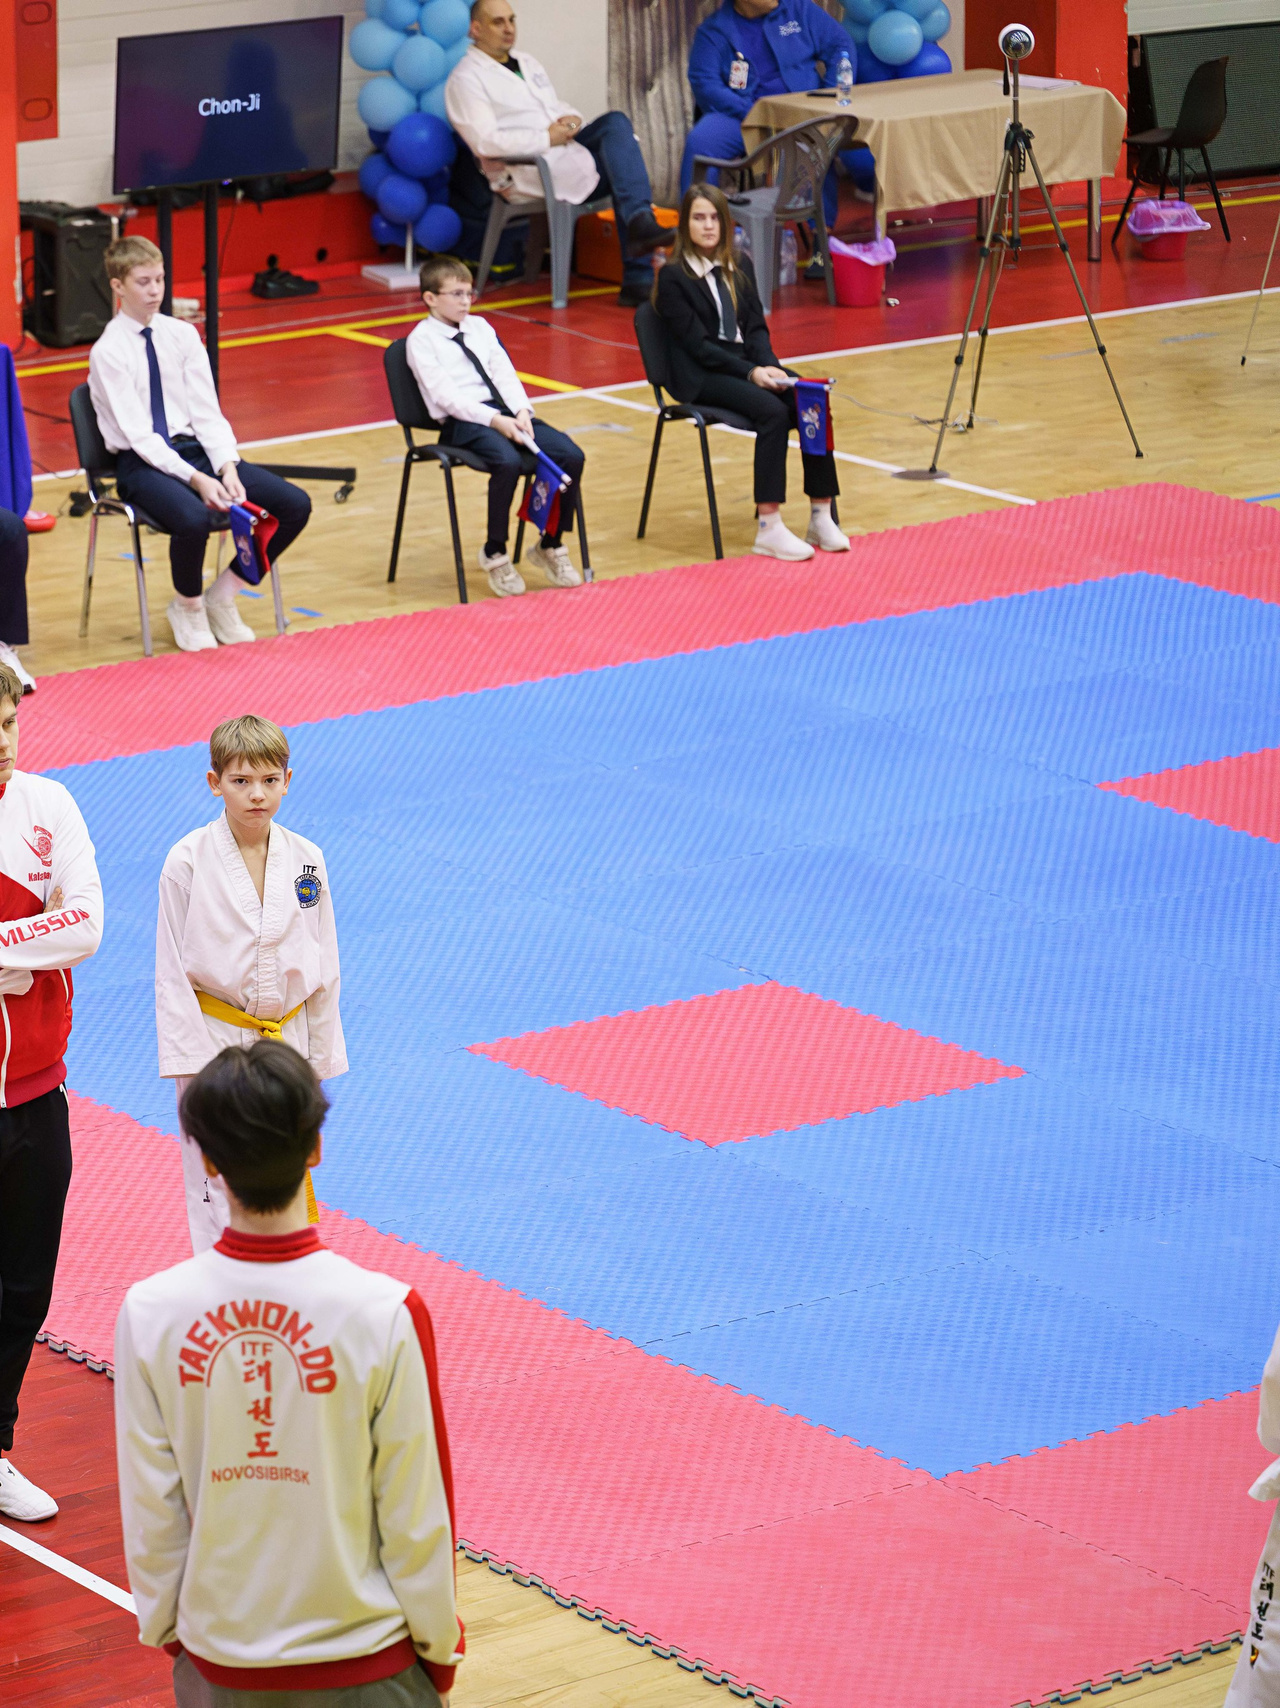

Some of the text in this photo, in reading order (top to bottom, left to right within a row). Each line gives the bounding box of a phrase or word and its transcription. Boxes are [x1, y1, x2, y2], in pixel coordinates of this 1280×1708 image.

[198, 93, 261, 117] Chon-Ji
[303, 864, 317, 874] ITF
[178, 1299, 337, 1394] TAEKWON-DO
[241, 1341, 274, 1357] ITF
[211, 1465, 311, 1486] NOVOSIBIRSK
